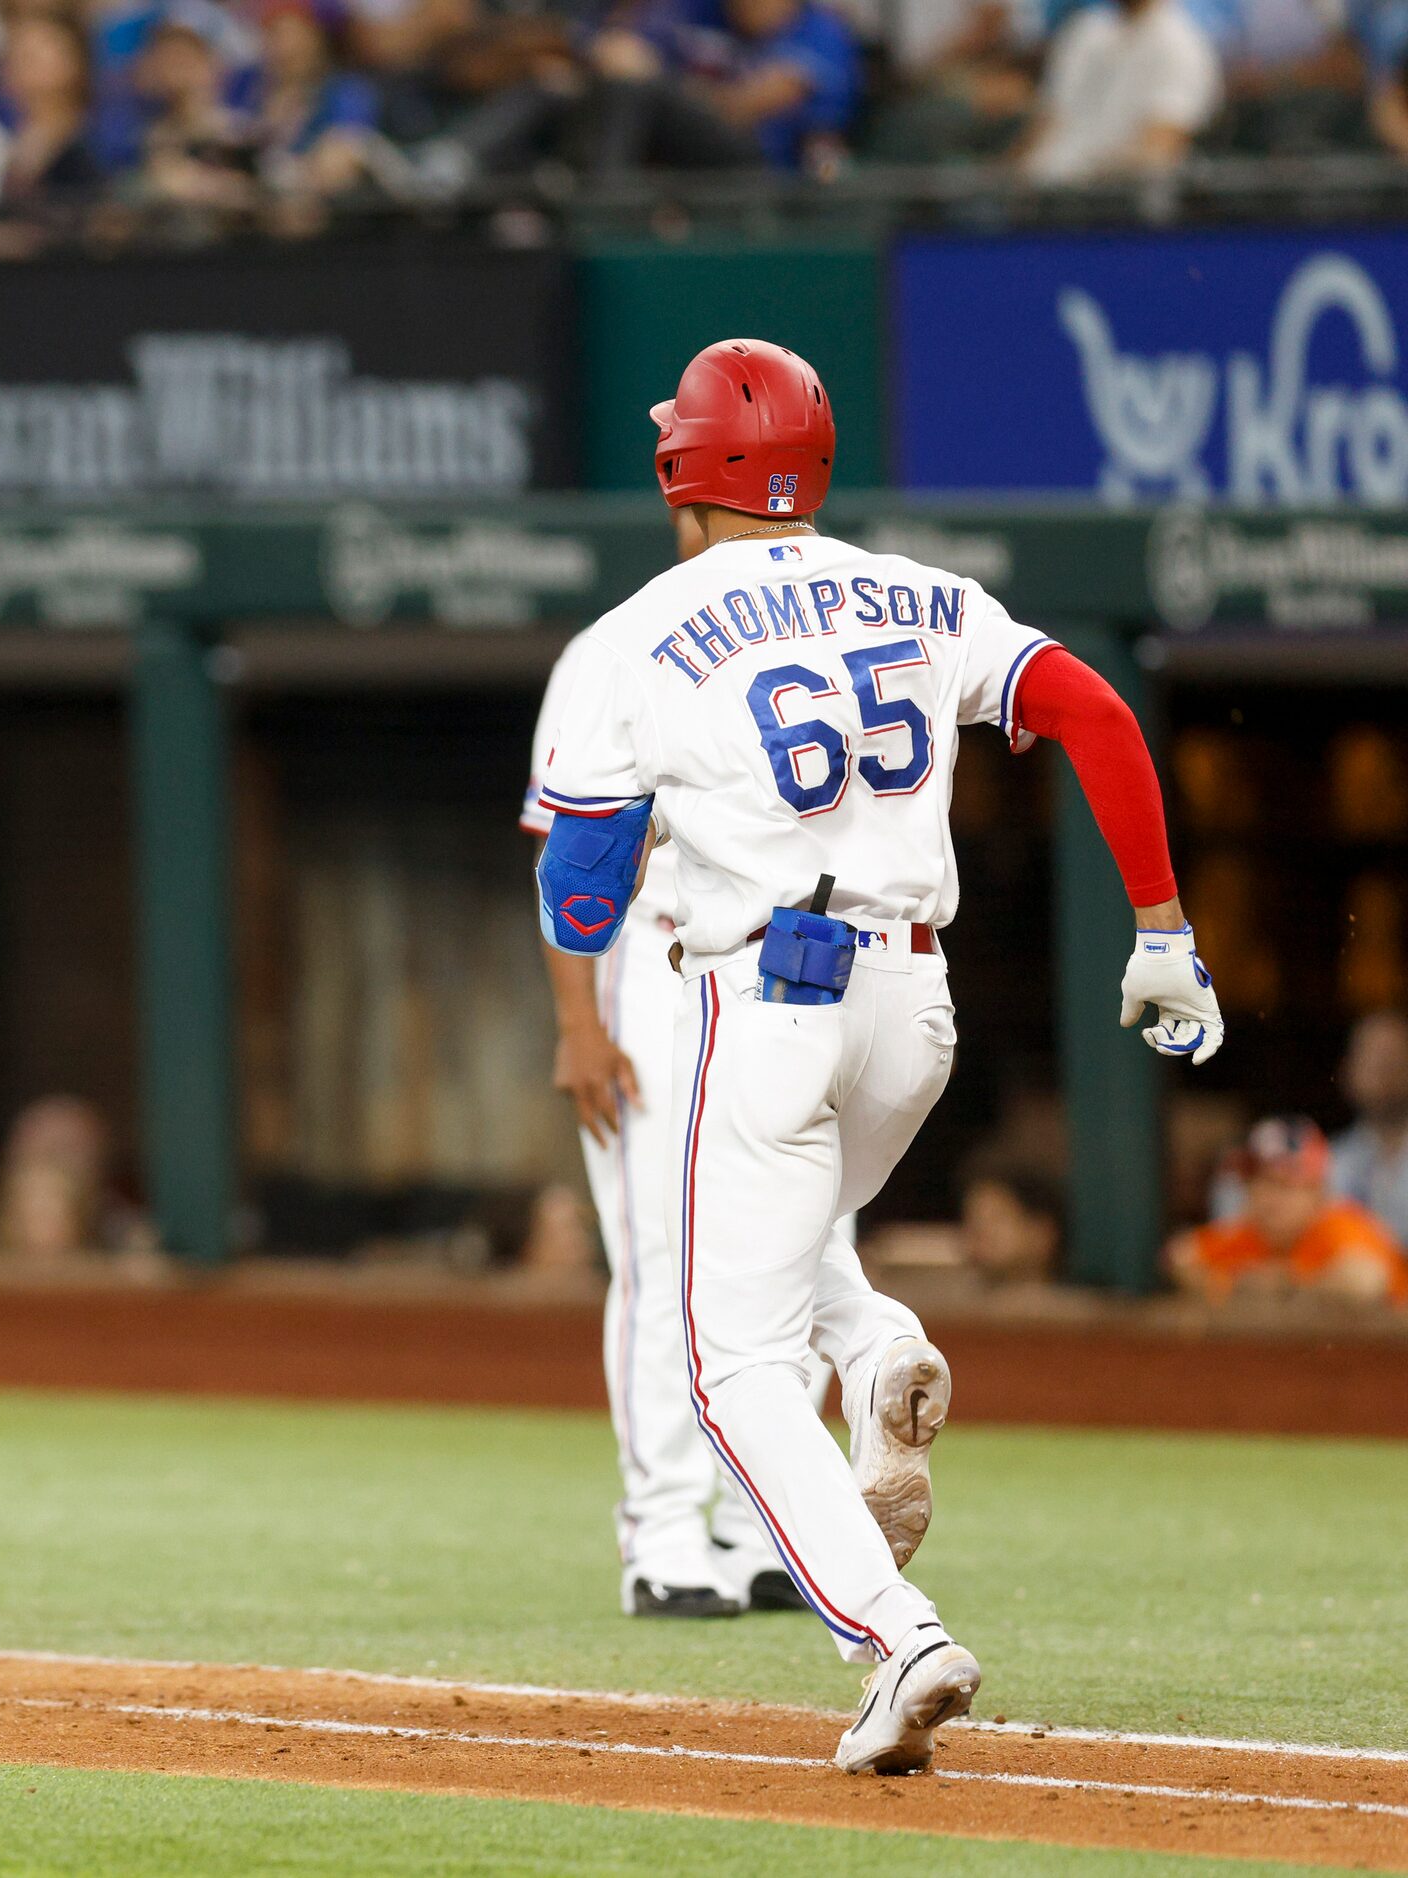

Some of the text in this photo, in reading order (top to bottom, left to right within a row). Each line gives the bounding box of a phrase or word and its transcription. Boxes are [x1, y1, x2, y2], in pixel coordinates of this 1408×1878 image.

[768, 474, 798, 494] 65
[650, 577, 965, 688] THOMPSON
[744, 639, 933, 819] 65
